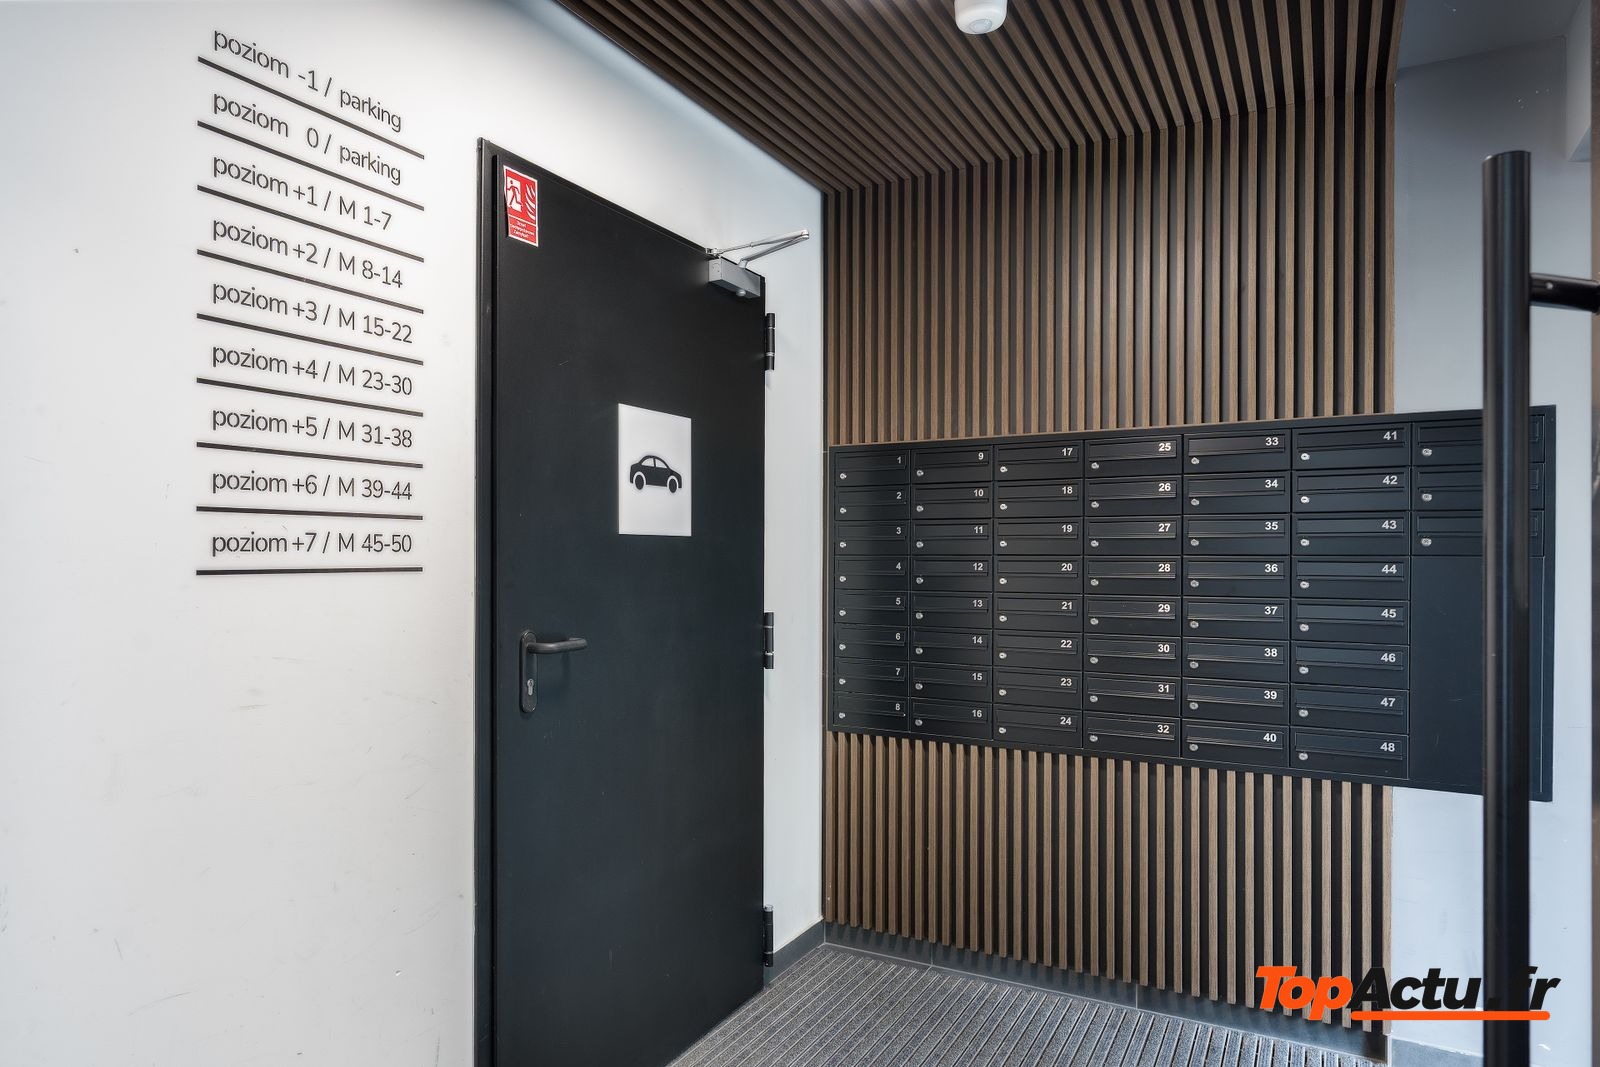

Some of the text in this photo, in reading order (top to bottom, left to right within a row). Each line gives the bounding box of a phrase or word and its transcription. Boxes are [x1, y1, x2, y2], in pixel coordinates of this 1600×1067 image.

[214, 30, 401, 132] poziom -1 / parking
[214, 93, 400, 186] poziom 0 / parking
[213, 156, 392, 230] poziom +1 / M 1-7
[213, 220, 402, 288] poziom +2 / M 8-14
[213, 284, 412, 343] poziom +3 / M 15-22
[213, 347, 412, 395] poziom +4 / M 23-30
[213, 409, 412, 447] poziom +5 / M 31-38
[1383, 430, 1397, 441] 41
[1265, 436, 1279, 446] 33
[1061, 447, 1073, 457] 17
[1158, 442, 1172, 452] 25
[896, 456, 902, 464] 1
[978, 452, 984, 461] 9
[1265, 479, 1279, 489] 34
[1382, 475, 1398, 485] 42
[213, 471, 412, 500] poziom +6 / M 39-44
[1061, 485, 1073, 495] 18
[1158, 482, 1172, 492] 26
[896, 491, 902, 500] 2
[973, 488, 984, 497] 10
[973, 525, 983, 534] 11
[1061, 524, 1073, 533] 19
[1158, 522, 1171, 532] 27
[1264, 521, 1279, 531] 35
[1381, 519, 1397, 530] 43
[896, 526, 902, 535] 3
[213, 532, 412, 556] poziom +7 / M 45-50
[895, 562, 902, 570] 4
[972, 562, 984, 571] 12
[1061, 562, 1073, 572] 20
[1158, 563, 1171, 573] 28
[1264, 563, 1278, 573] 36
[1381, 564, 1398, 574] 44
[895, 597, 901, 606] 5
[972, 599, 983, 608] 13
[1061, 601, 1073, 610] 21
[1158, 603, 1171, 613] 29
[1264, 605, 1278, 615] 37
[1381, 608, 1397, 619] 45
[895, 632, 901, 641] 6
[972, 635, 983, 645] 14
[1060, 639, 1073, 648] 22
[1157, 643, 1170, 653] 30
[1264, 647, 1278, 658] 38
[1380, 652, 1396, 663] 46
[895, 667, 901, 676] 7
[972, 672, 983, 681] 15
[1060, 677, 1073, 687] 23
[1158, 684, 1170, 693] 31
[1263, 690, 1278, 700] 39
[895, 702, 901, 711] 8
[1380, 697, 1396, 707] 47
[972, 709, 983, 718] 16
[1060, 716, 1072, 726] 24
[1157, 724, 1170, 734] 32
[1263, 732, 1277, 743] 40
[1380, 742, 1396, 752] 48
